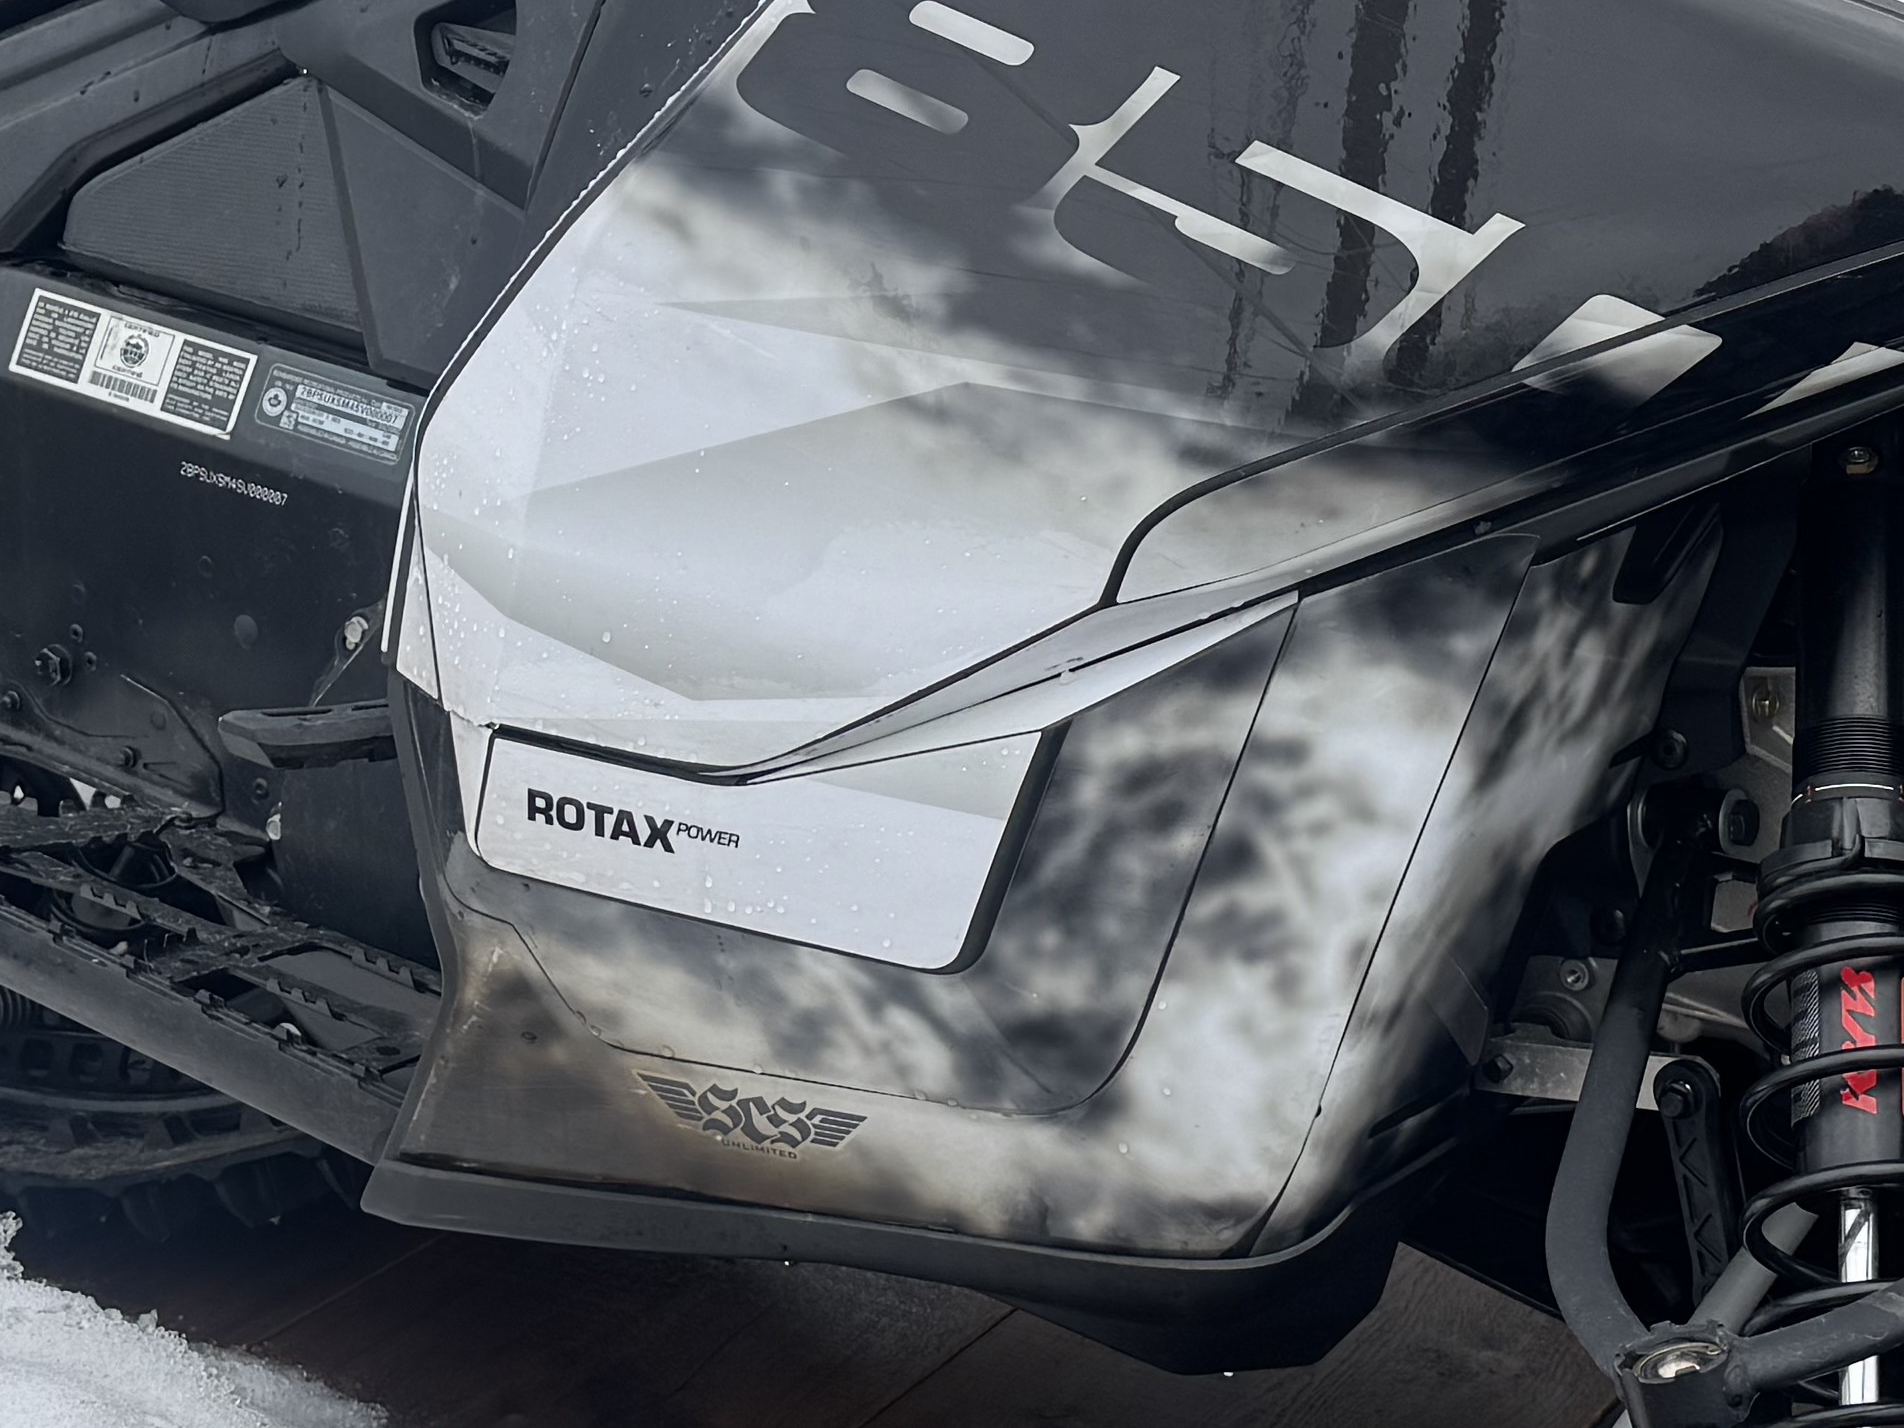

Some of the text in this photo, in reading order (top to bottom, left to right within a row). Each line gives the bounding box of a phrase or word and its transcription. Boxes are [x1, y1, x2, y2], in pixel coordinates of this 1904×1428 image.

[526, 787, 741, 854] ROTAX POWER
[720, 1137, 798, 1160] UNLIMITED
